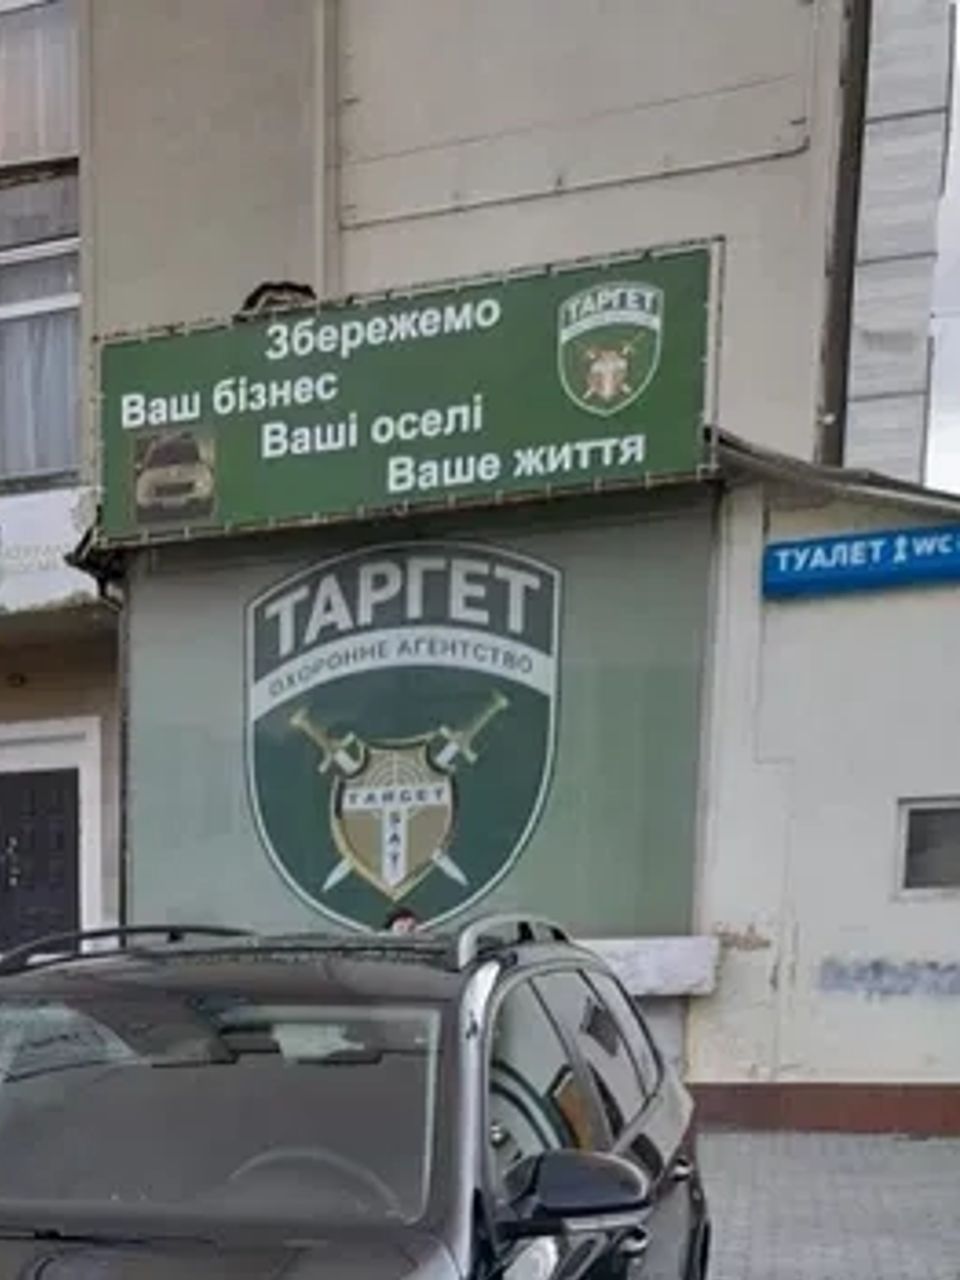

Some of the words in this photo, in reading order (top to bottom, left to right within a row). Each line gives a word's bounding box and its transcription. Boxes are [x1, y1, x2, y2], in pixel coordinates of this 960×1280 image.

[265, 298, 501, 360] Збережемо
[566, 287, 656, 321] ТАРГЕТ
[121, 391, 201, 429] Ваш
[212, 372, 339, 416] бізнес
[261, 412, 358, 459] Ваші
[370, 394, 483, 444] оселі
[387, 453, 501, 493] Ваше
[513, 434, 646, 478] життя
[773, 538, 887, 572] ТУАЛЕТ
[265, 556, 540, 658] ТАРГЕТ
[268, 640, 388, 697] ОХОРОННЕ
[397, 638, 533, 674] АГЕНТСТВО
[348, 786, 445, 806] TARGET
